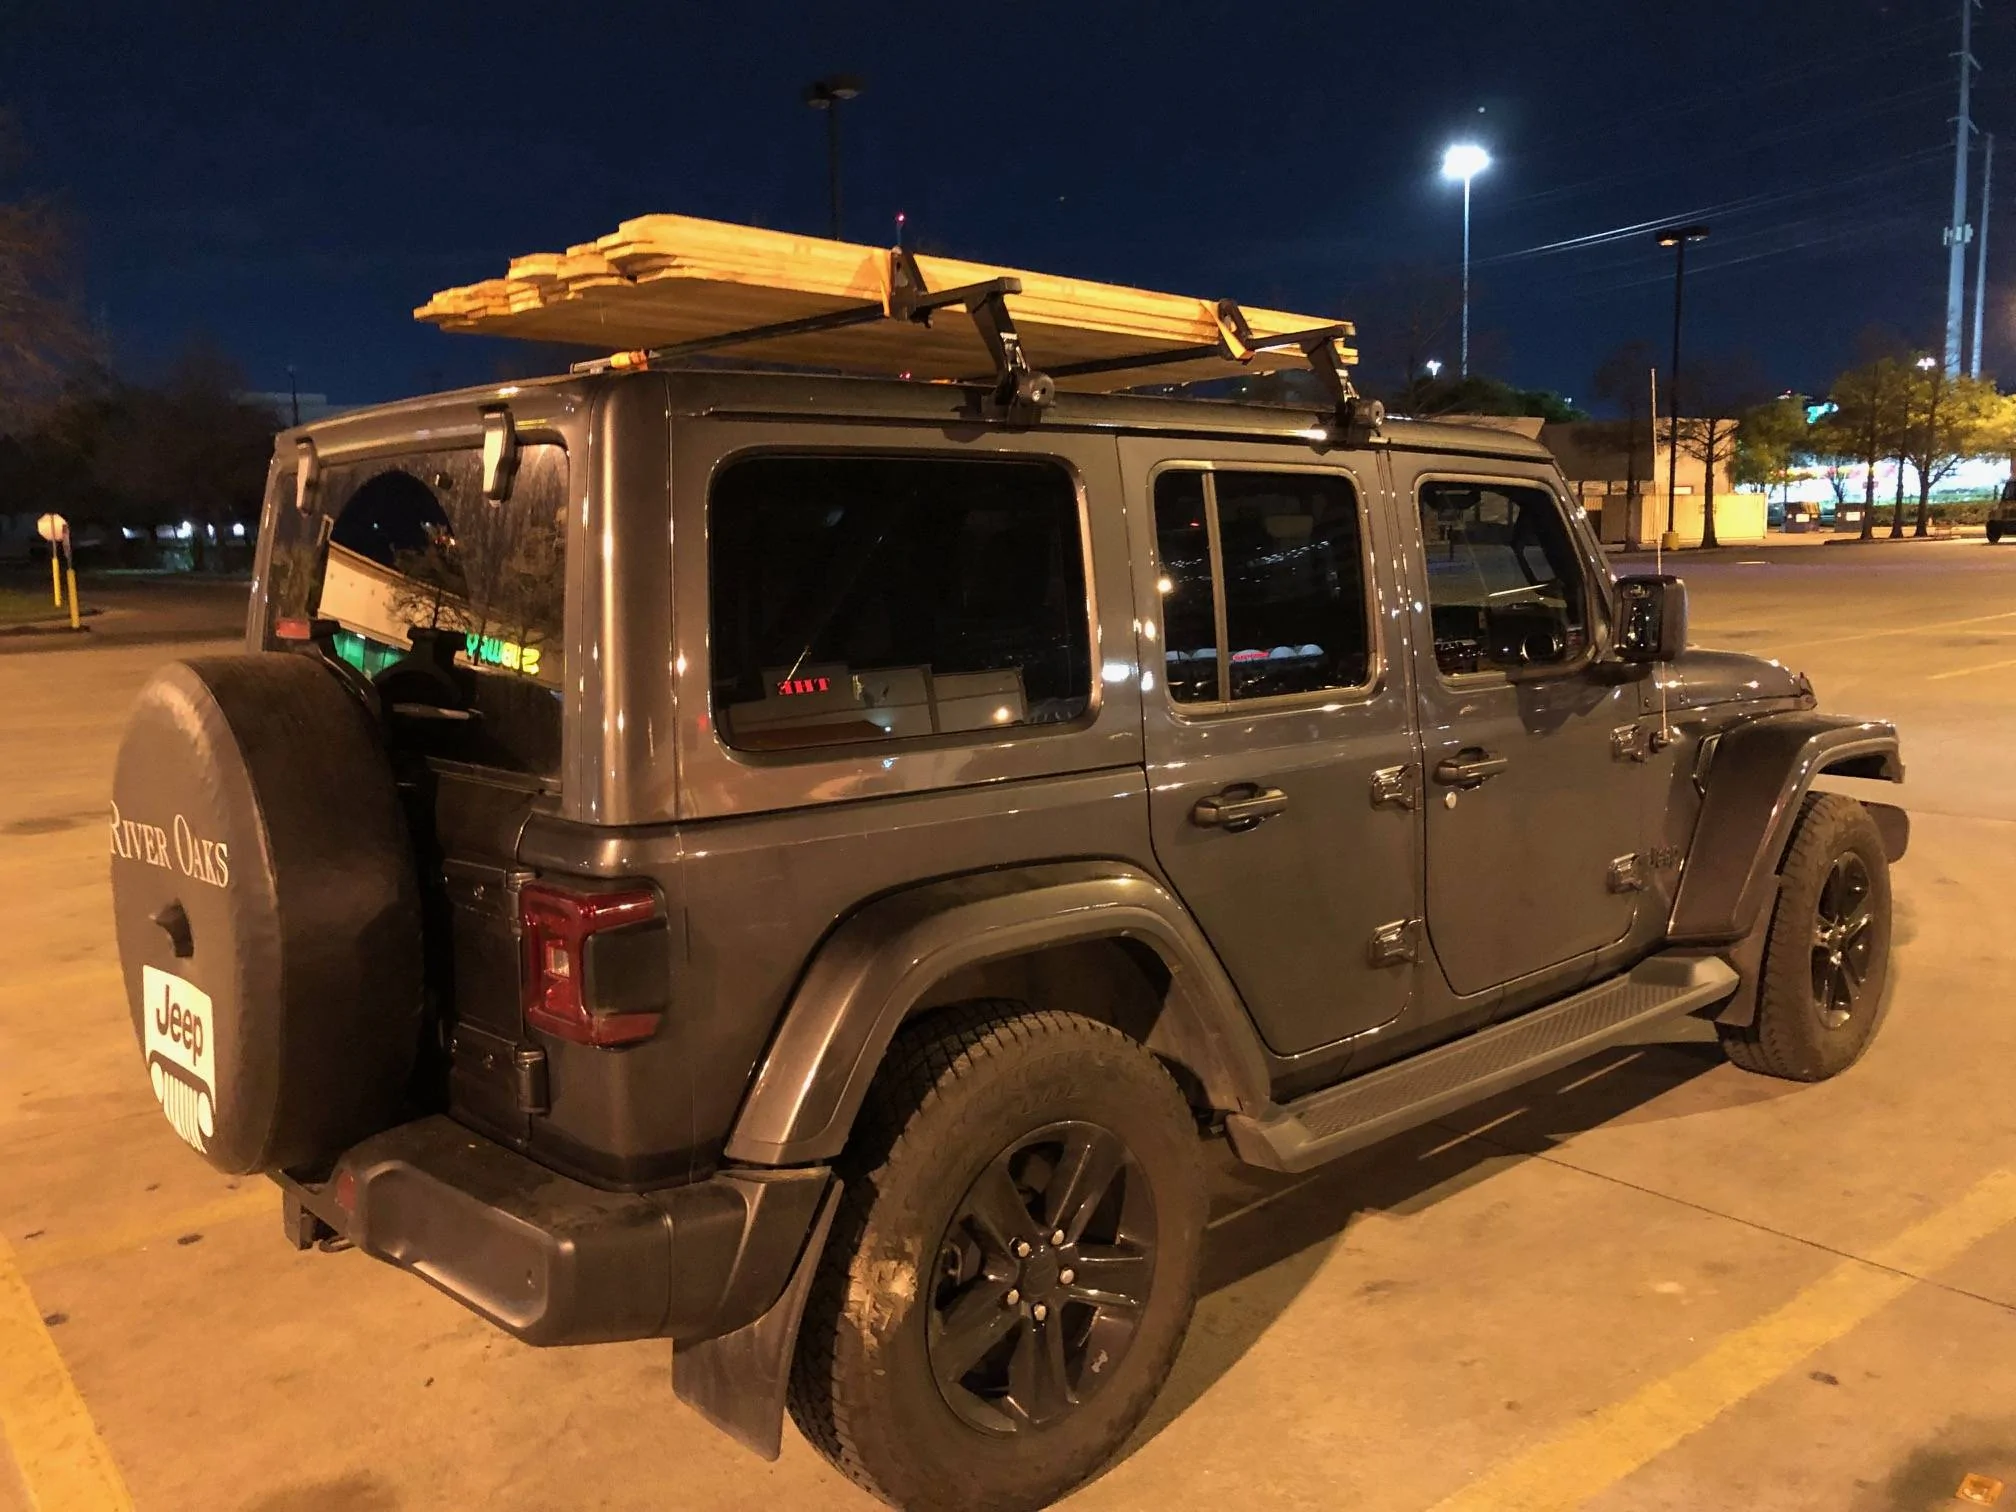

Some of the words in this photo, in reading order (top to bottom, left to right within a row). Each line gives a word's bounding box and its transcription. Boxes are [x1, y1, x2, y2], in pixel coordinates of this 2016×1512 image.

[110, 800, 172, 870] RIVER
[174, 814, 228, 888] OAKS
[156, 984, 203, 1067] Jeep
